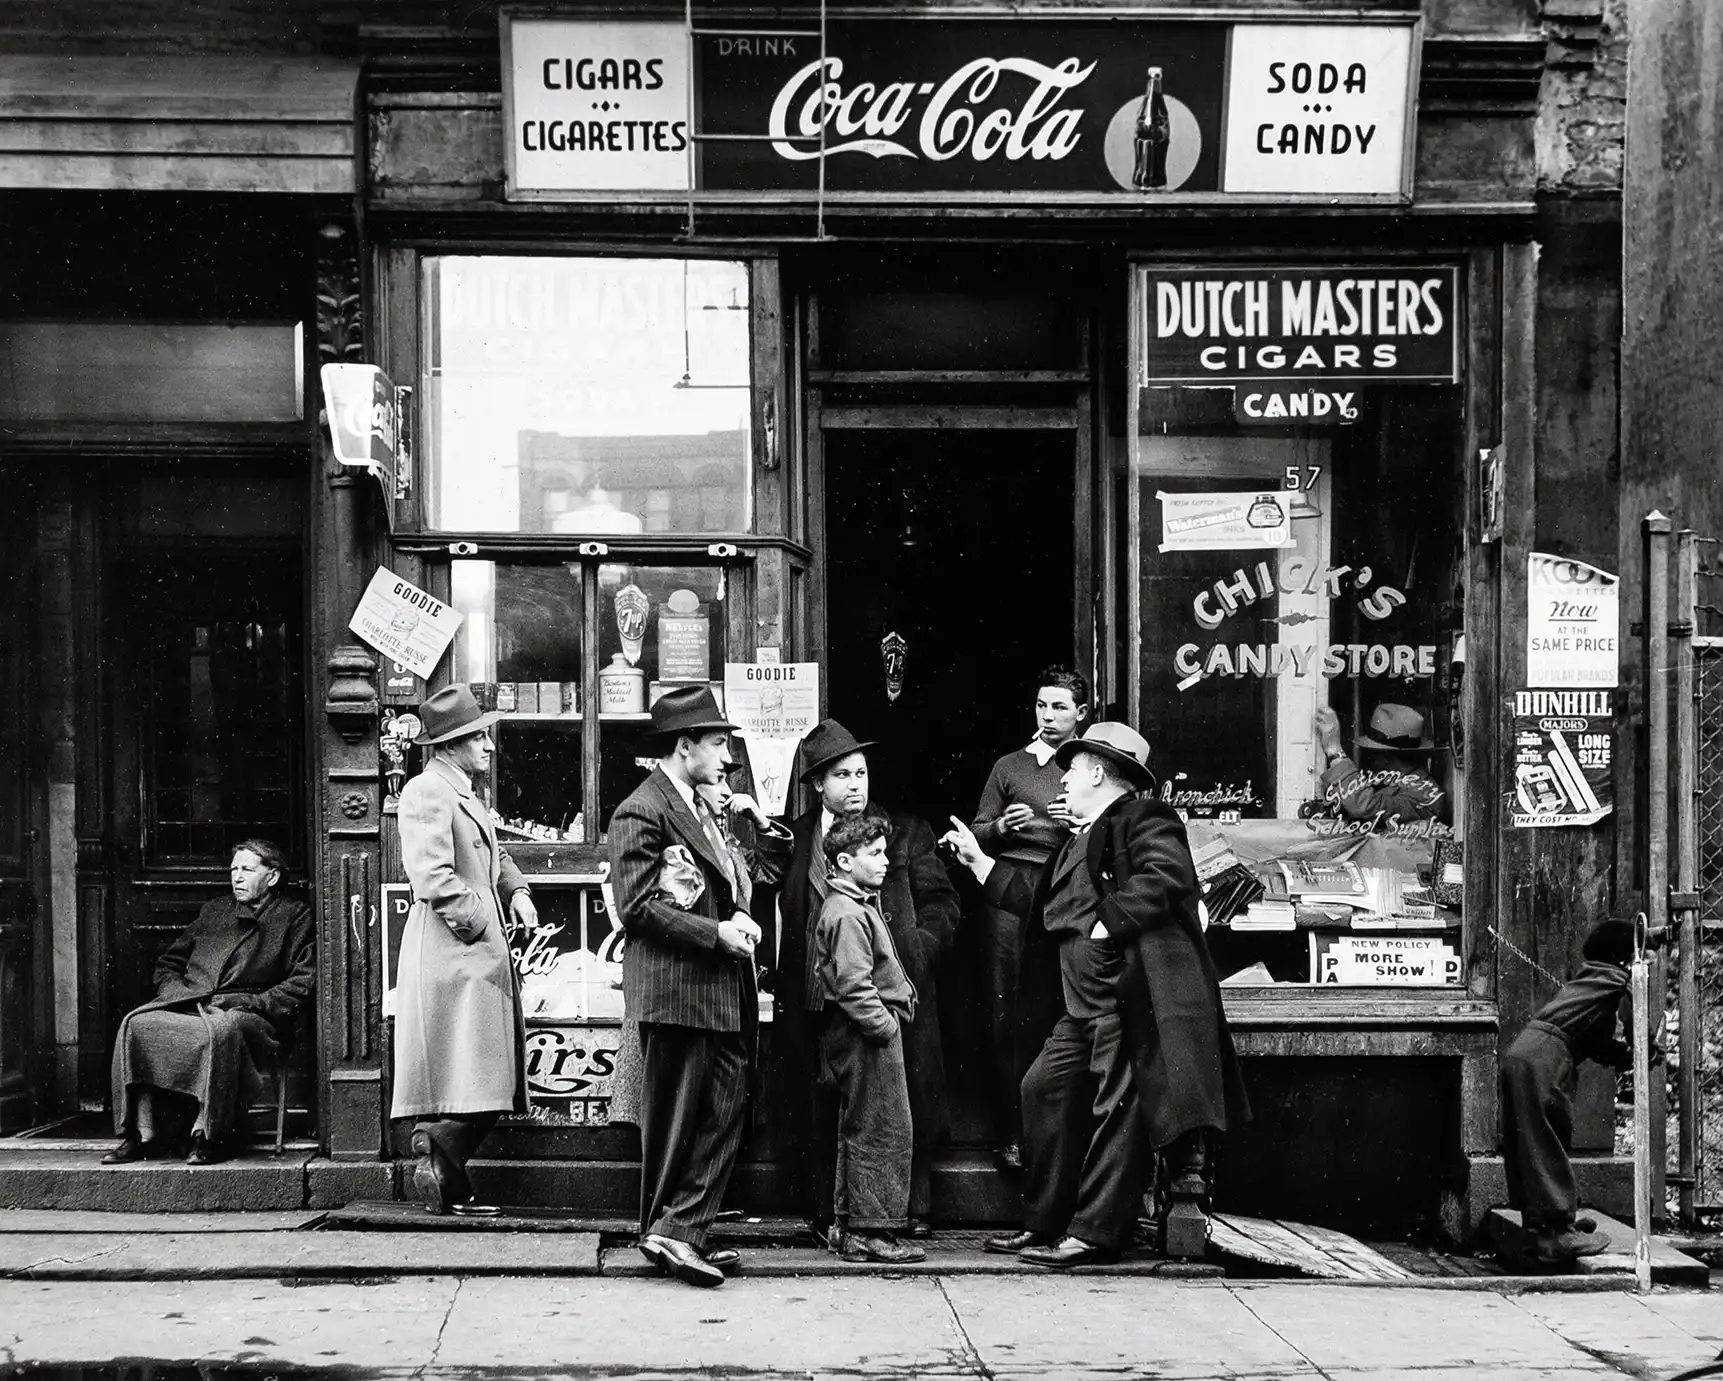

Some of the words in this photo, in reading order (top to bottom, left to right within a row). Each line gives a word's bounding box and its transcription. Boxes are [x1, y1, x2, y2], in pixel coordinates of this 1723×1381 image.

[719, 38, 797, 57] DRINK
[543, 58, 664, 91] CIGARS
[1267, 62, 1367, 94] SODA
[768, 56, 1098, 161] Coca-Cola
[522, 120, 687, 152] CIGARETTES
[1256, 123, 1376, 154] CANDY
[1156, 280, 1267, 338] DUTCH
[1281, 278, 1443, 336] MASTERS
[1200, 344, 1397, 370] CIGARS
[1243, 392, 1354, 418] CANDY
[1285, 466, 1322, 490] 57
[393, 581, 443, 618] GOODIE
[1193, 555, 1407, 630] CHICK'S
[1557, 626, 1567, 635] AT
[1572, 626, 1588, 635] THE
[403, 645, 429, 665] RUSSE
[1531, 638, 1570, 651] SAME
[1575, 638, 1615, 652] PRICE
[1174, 643, 1317, 679] CANDY
[1320, 643, 1437, 679] STORE
[746, 667, 797, 681] GOODIE
[1516, 692, 1613, 716] DUNHILL
[785, 717, 809, 727] RUSSE
[1543, 719, 1585, 730] MAJORS
[1578, 734, 1611, 749] LONG
[1578, 749, 1611, 764] SIZE
[1325, 769, 1445, 813] Stationery
[1307, 810, 1386, 838] School
[1516, 815, 1536, 824] THEY
[1539, 815, 1562, 824] COST
[1386, 941, 1432, 949] POLICY
[1355, 953, 1404, 964] MORE
